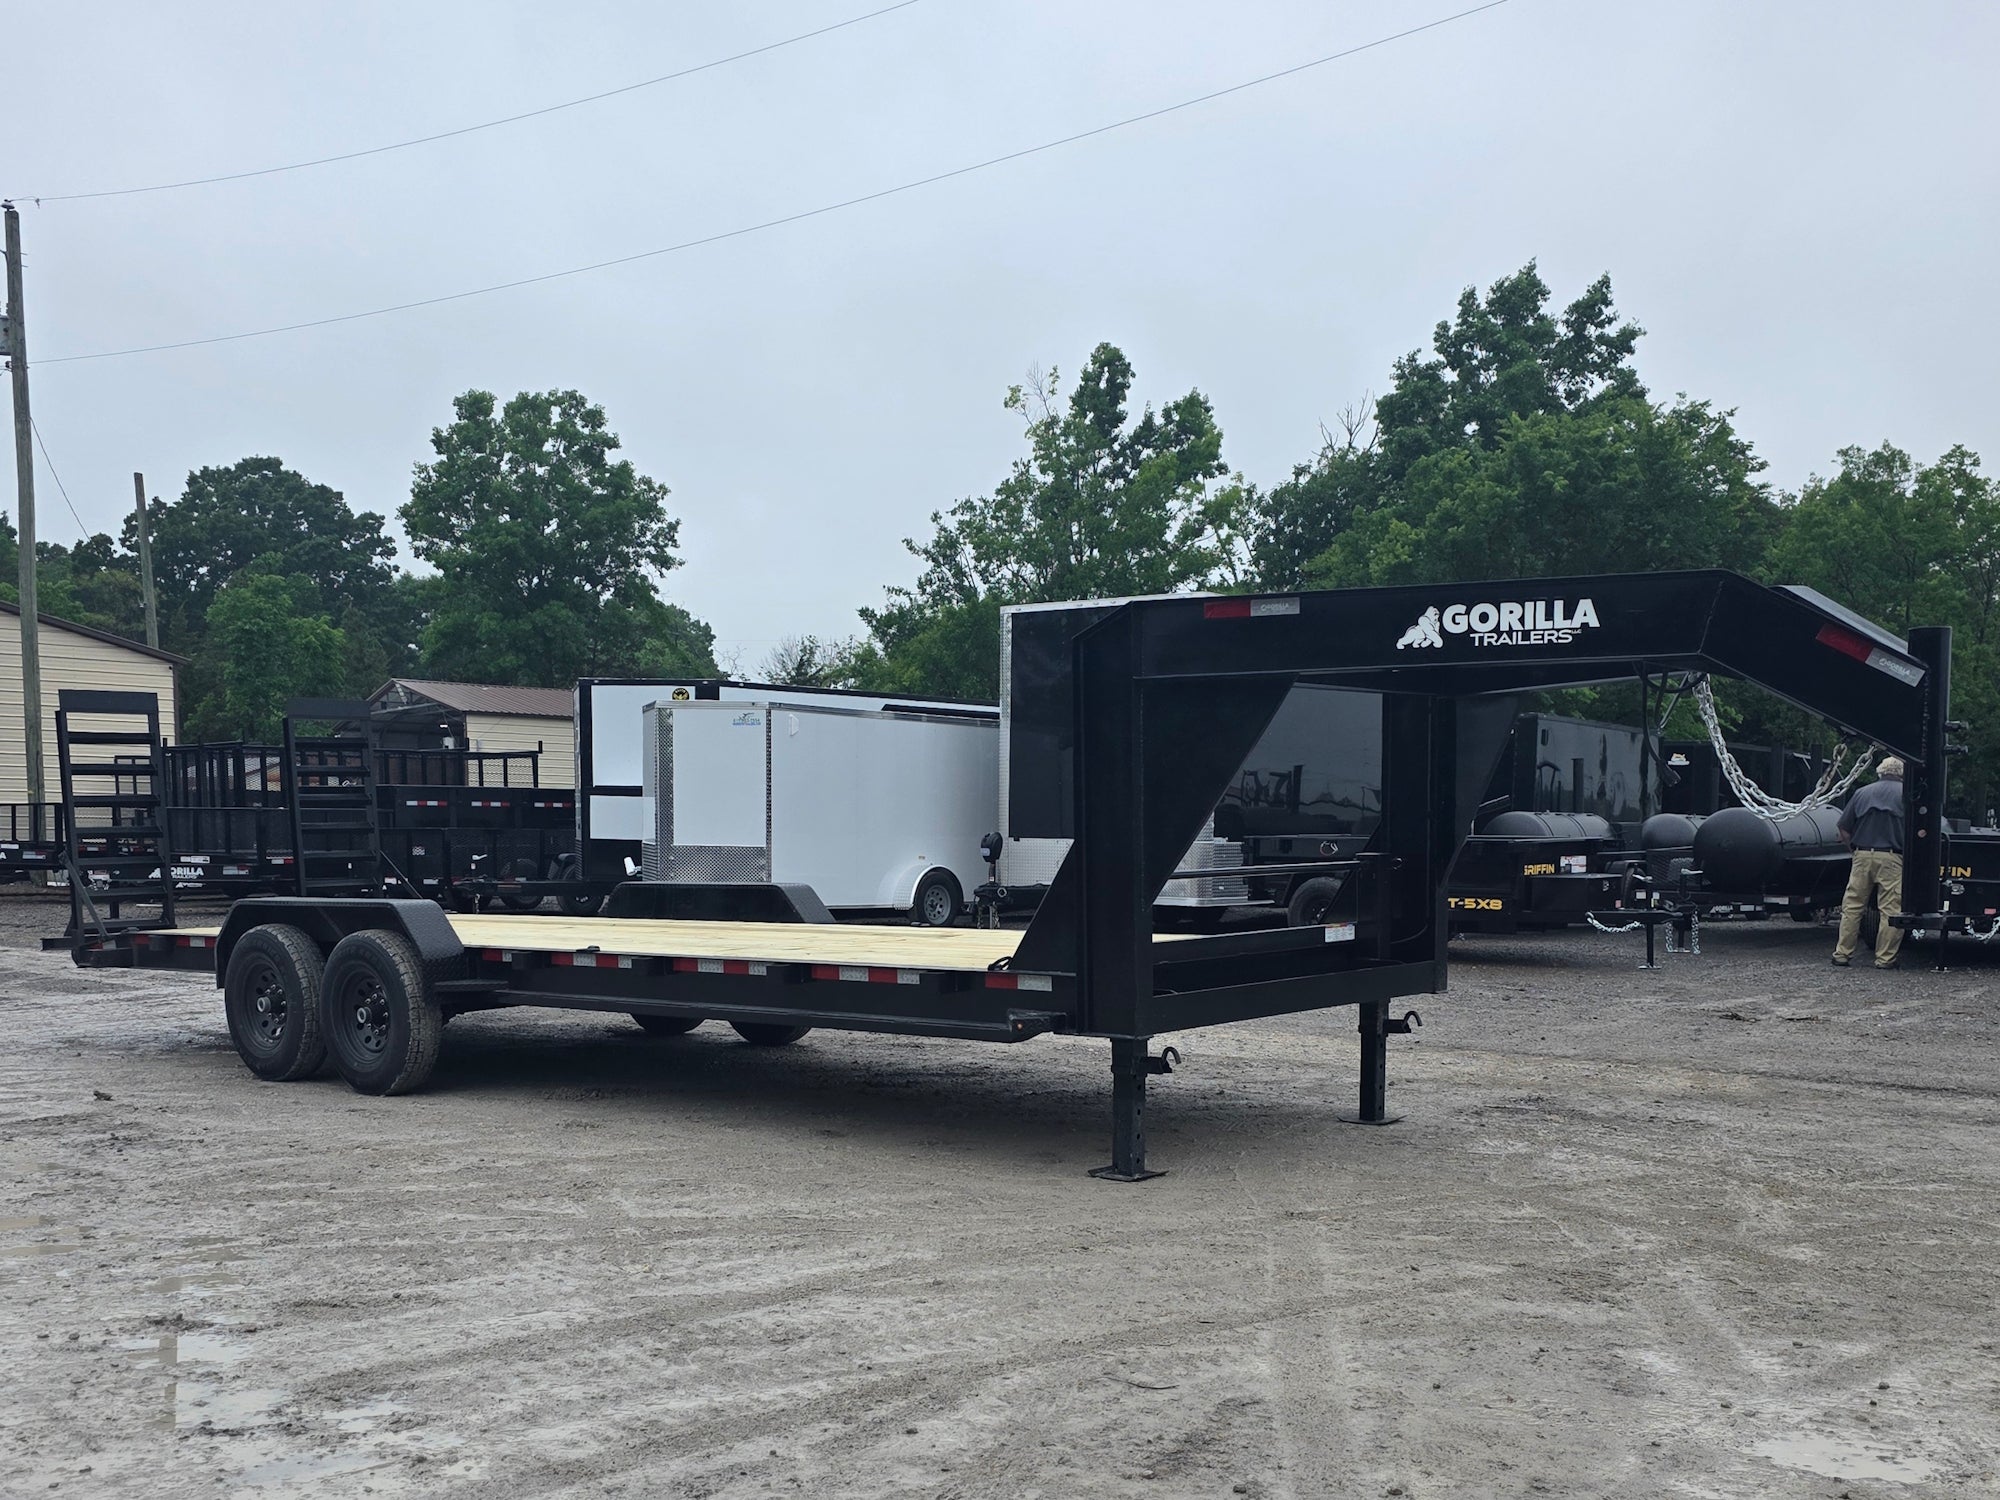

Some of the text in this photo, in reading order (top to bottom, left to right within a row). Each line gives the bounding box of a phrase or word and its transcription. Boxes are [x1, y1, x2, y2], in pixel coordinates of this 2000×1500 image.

[1442, 599, 1600, 633] GORILLA
[1470, 629, 1572, 646] TRAILERS
[171, 867, 204, 876] ORILLA
[1448, 898, 1502, 910] T-5X8
